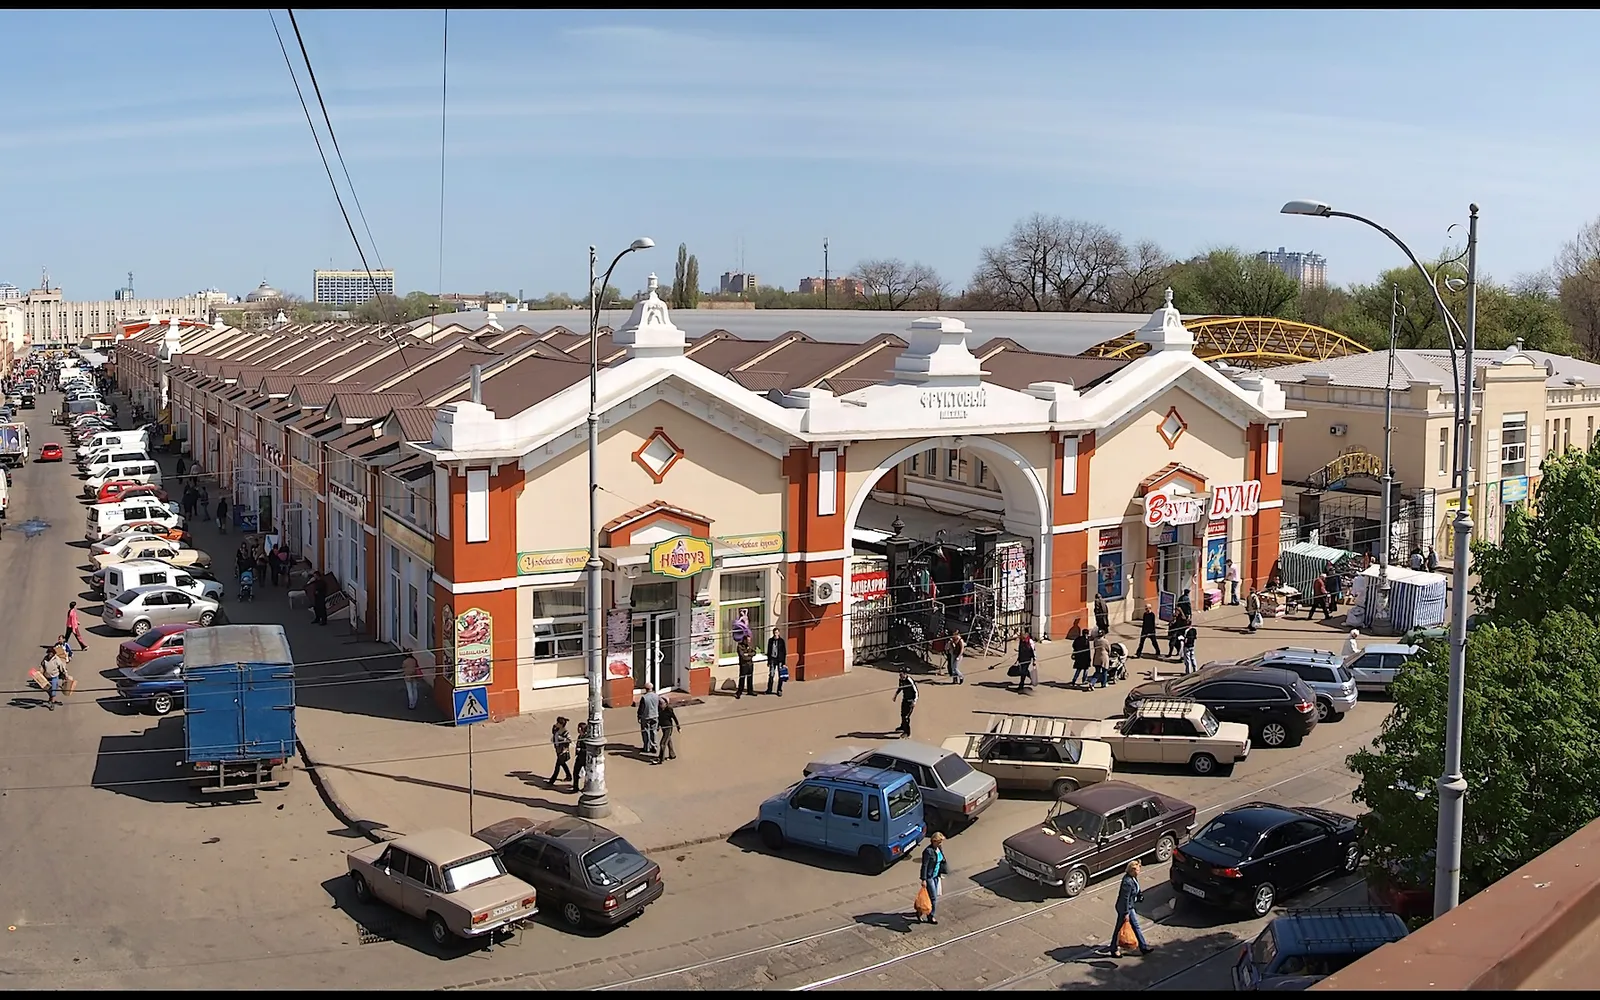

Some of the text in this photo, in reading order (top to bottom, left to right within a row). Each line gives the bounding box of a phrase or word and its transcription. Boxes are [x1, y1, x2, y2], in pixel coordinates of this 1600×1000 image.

[920, 388, 986, 408] ФРУКТОВЫЙ
[1212, 484, 1259, 515] БУМ!
[661, 551, 706, 568] НАВРУЗ
